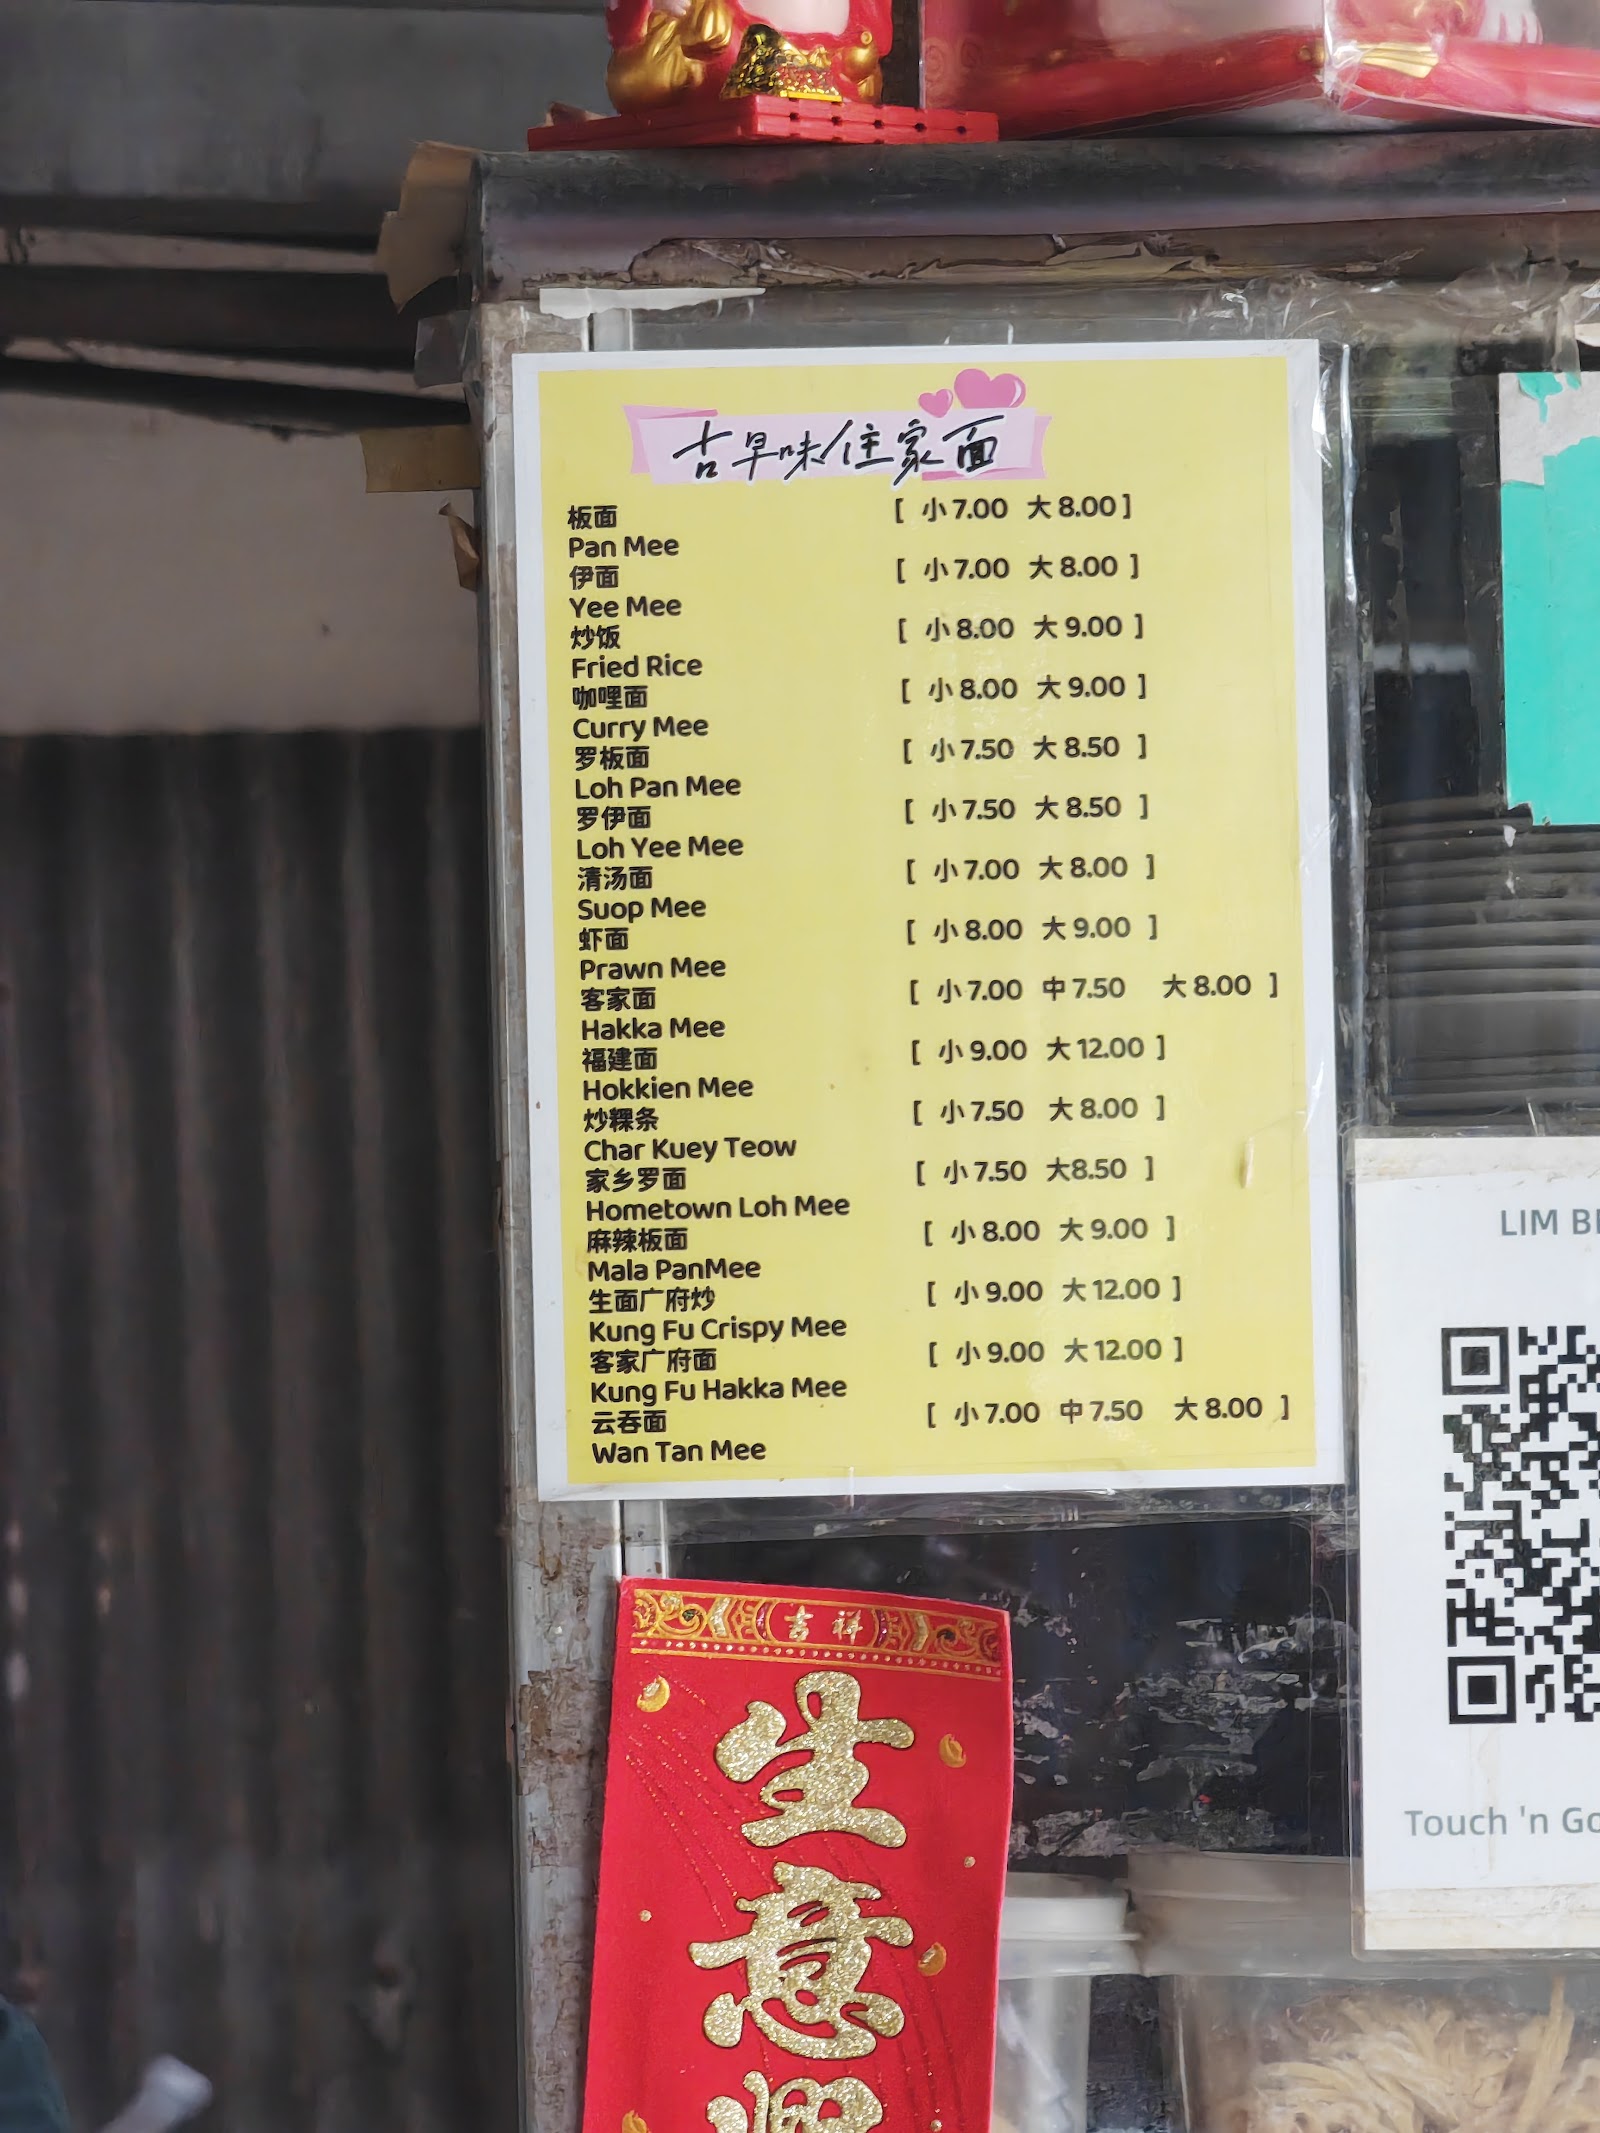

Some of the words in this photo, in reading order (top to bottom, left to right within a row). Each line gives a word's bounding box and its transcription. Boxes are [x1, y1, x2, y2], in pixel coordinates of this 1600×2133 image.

[566, 504, 619, 531] 板面
[568, 536, 617, 559] Pan
[623, 535, 680, 558] Mee
[568, 564, 620, 591] 伊面
[568, 597, 620, 619] Yee
[626, 595, 683, 618] Mee
[569, 624, 621, 651] 炒饭
[571, 654, 640, 680] Fried
[646, 652, 703, 677] Rice
[571, 684, 649, 711] 咖哩面
[572, 717, 647, 743] Curry
[652, 715, 710, 738] Mee
[574, 745, 650, 772] 罗板面
[575, 776, 624, 800] Loh
[630, 776, 679, 799] Pan
[685, 775, 742, 797] Mee
[576, 805, 652, 832] 罗伊面
[576, 836, 625, 860] Loh
[630, 836, 682, 859] Yee
[687, 835, 745, 857] Mee
[577, 865, 654, 893] 清汤面
[577, 898, 645, 924] Suop
[650, 896, 707, 919] Mee
[578, 926, 630, 953] 虾面
[579, 959, 664, 981] Prawn
[670, 956, 727, 979] Mee
[580, 985, 657, 1012] 客家面
[581, 1016, 663, 1041] Hakka
[669, 1016, 726, 1039] Mee
[581, 1046, 658, 1074] 福建面
[582, 1075, 692, 1102] Hokkien
[697, 1076, 755, 1099] Mee
[583, 1106, 660, 1134] 炒粿条
[583, 1138, 646, 1162] Char
[652, 1137, 719, 1164] Kuey
[723, 1136, 798, 1159] Teow
[584, 1166, 687, 1194] 家乡罗面
[586, 1198, 733, 1222] Hometown
[738, 1194, 788, 1218] Loh
[794, 1194, 851, 1217] Mee
[1501, 1209, 1558, 1236] LIM
[1572, 1208, 1600, 1235] B
[586, 1226, 689, 1255] 麻辣板面
[587, 1258, 649, 1283] Mala
[655, 1257, 762, 1281] PanMee
[588, 1285, 716, 1315] 生面广府炒
[589, 1320, 656, 1347] Kung
[662, 1319, 695, 1341] Fu
[700, 1314, 785, 1344] Crispy
[790, 1315, 848, 1338] Mee
[589, 1346, 718, 1375] 客家广府面
[590, 1381, 658, 1408] Kung
[664, 1380, 697, 1402] Fu
[702, 1376, 785, 1401] Hakka
[791, 1376, 848, 1399] Mee
[590, 1409, 668, 1436] 云吞面
[591, 1441, 649, 1465] Wan
[654, 1441, 704, 1463] Tan
[710, 1439, 767, 1461] Mee
[783, 1604, 864, 1646] 吉祥
[1404, 1806, 1507, 1836] Touch
[1520, 1805, 1548, 1834] 'n
